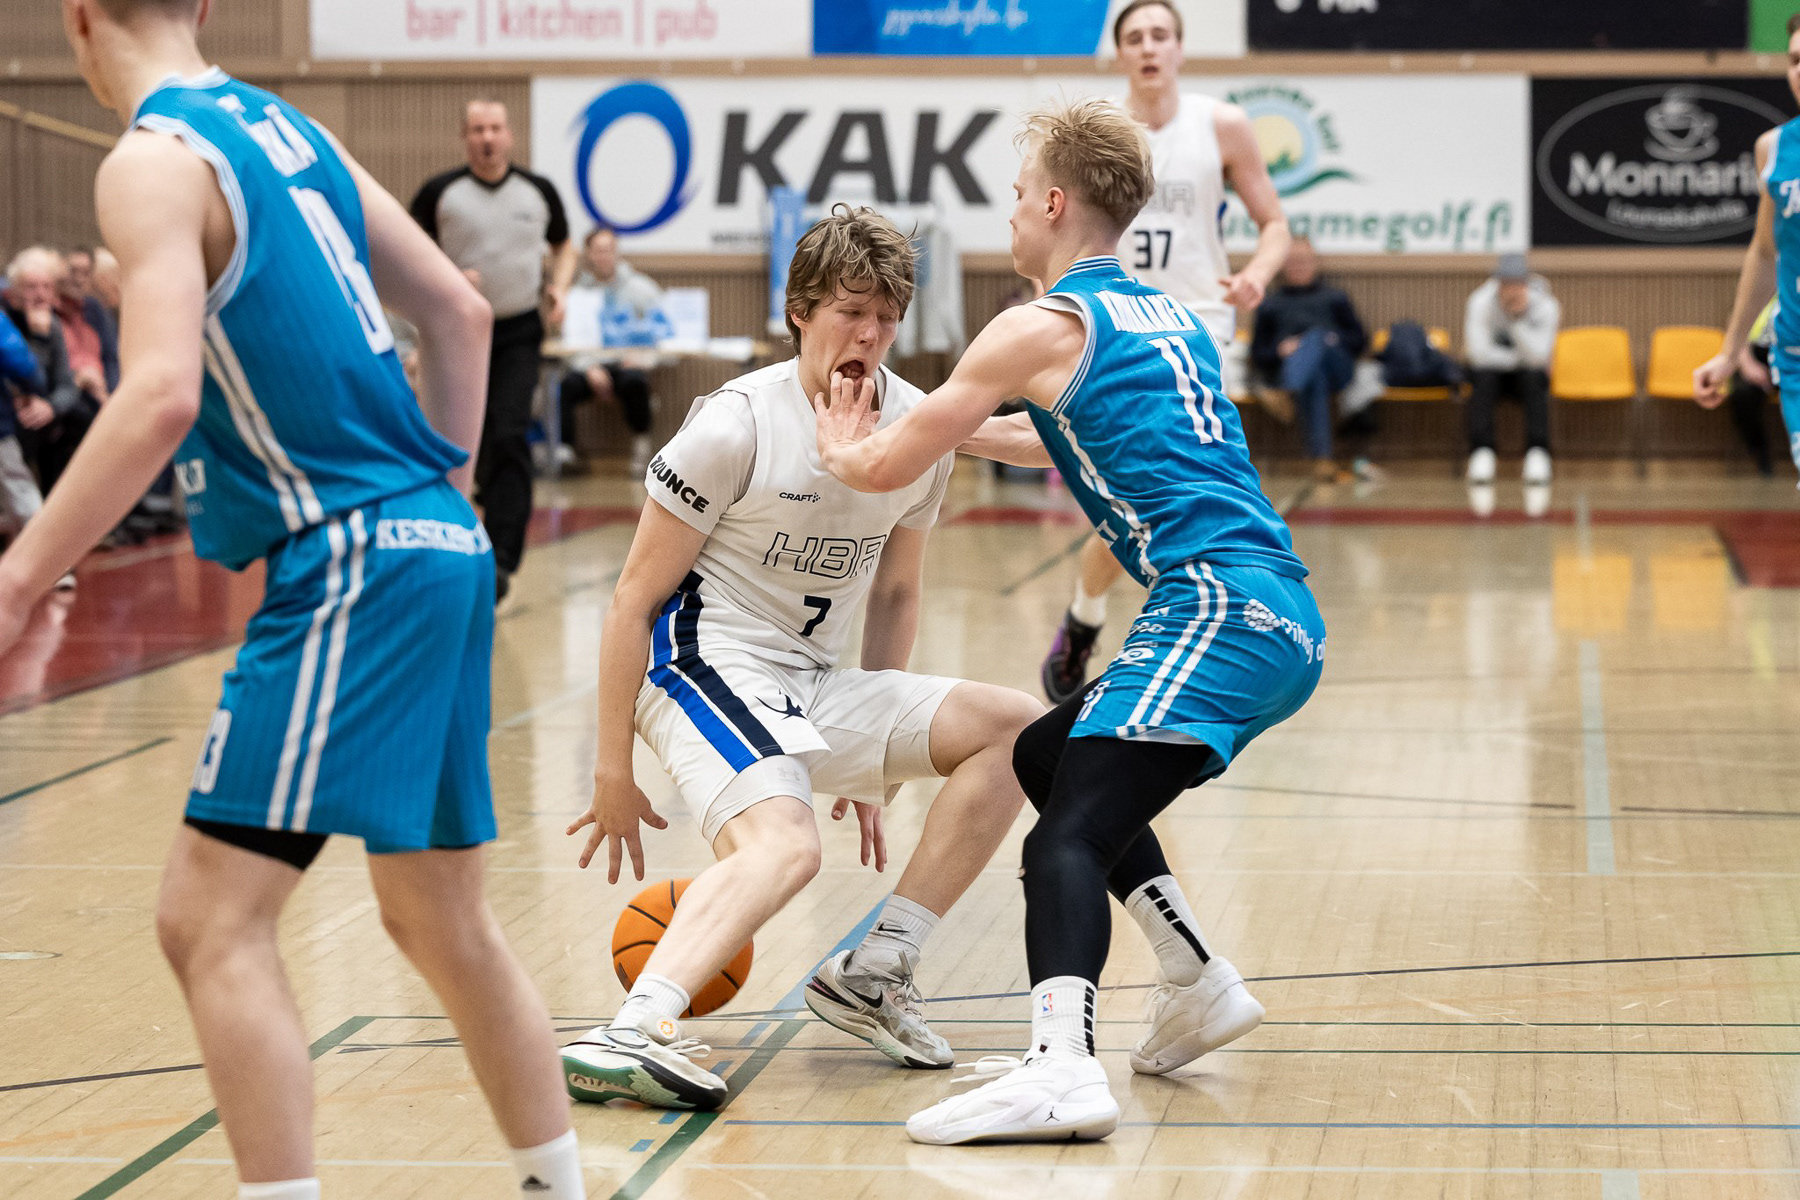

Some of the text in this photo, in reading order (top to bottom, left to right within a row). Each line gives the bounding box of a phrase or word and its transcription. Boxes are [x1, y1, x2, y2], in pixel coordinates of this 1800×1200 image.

[406, 0, 718, 46] bar kitchen pub
[1567, 152, 1760, 197] Monnari
[1133, 230, 1172, 270] 37
[1146, 335, 1227, 444] 11
[779, 491, 813, 502] CRAFT
[799, 595, 833, 637] 7
